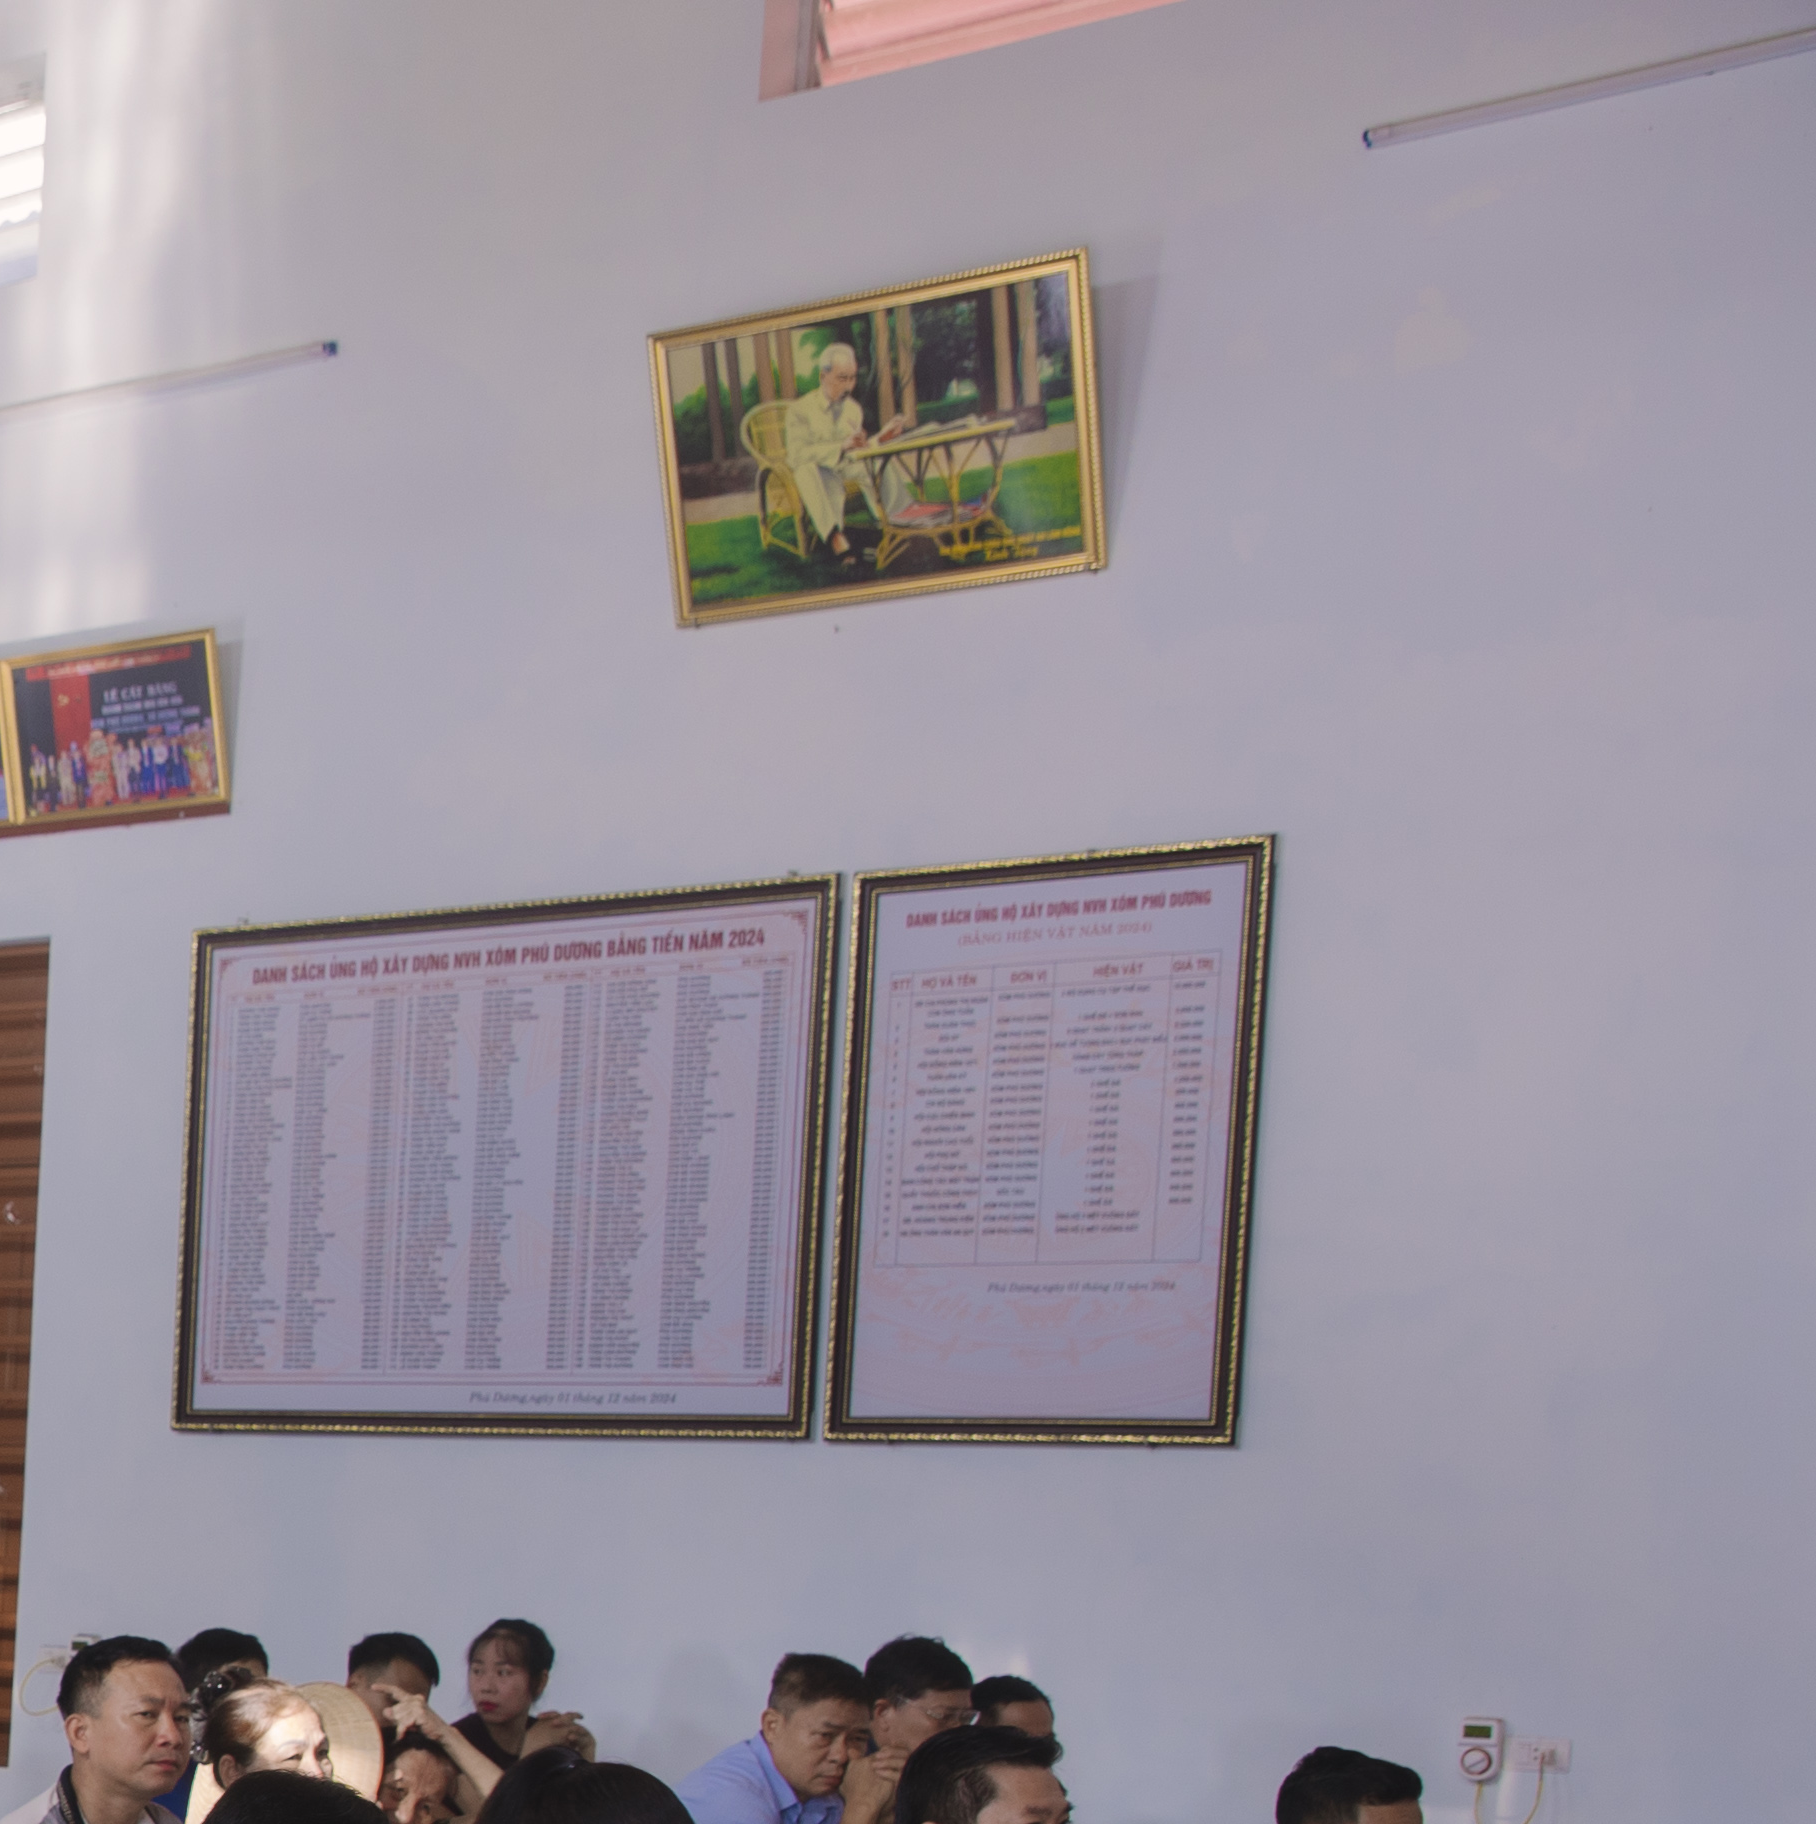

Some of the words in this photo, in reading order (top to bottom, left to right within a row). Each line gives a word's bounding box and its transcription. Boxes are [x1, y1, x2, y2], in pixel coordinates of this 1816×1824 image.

[906, 912, 938, 928] DANH
[941, 907, 971, 925] SÁCH
[1082, 899, 1107, 915] NVH
[1110, 894, 1138, 913] XÓM
[252, 966, 287, 985] DANH
[291, 959, 325, 982] SÁCH
[360, 956, 378, 980] HỘ
[382, 953, 409, 975] XÂY
[412, 953, 450, 977] DỰNG
[454, 951, 481, 968] NVH
[485, 945, 516, 966] XÓM
[521, 942, 548, 964] PHÚ
[554, 938, 602, 962] DƯƠNG
[689, 928, 723, 951] NĂM
[728, 927, 765, 950] 2024
